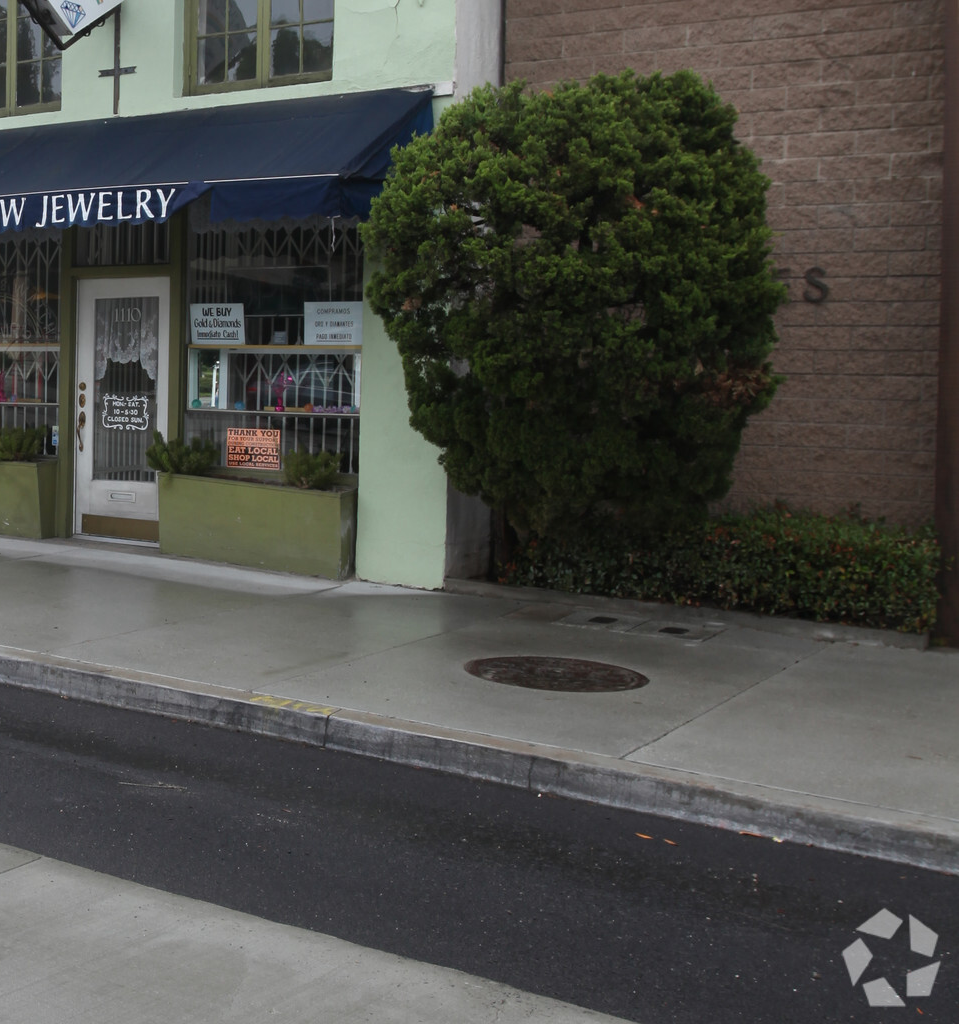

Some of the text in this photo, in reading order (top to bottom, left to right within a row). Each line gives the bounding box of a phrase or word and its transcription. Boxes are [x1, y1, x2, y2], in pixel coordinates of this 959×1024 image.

[35, 188, 176, 228] JEWELRY
[115, 307, 142, 323] 1110
[202, 307, 232, 317] WE BUY
[194, 318, 208, 328] Gold
[213, 317, 242, 328] Diamonds
[329, 320, 354, 328] DIAMANTES
[222, 330, 239, 338] Cash!
[228, 429, 279, 438] THANK YOU
[228, 446, 279, 456] EAT LOCAL
[251, 454, 279, 463] LOCAL
